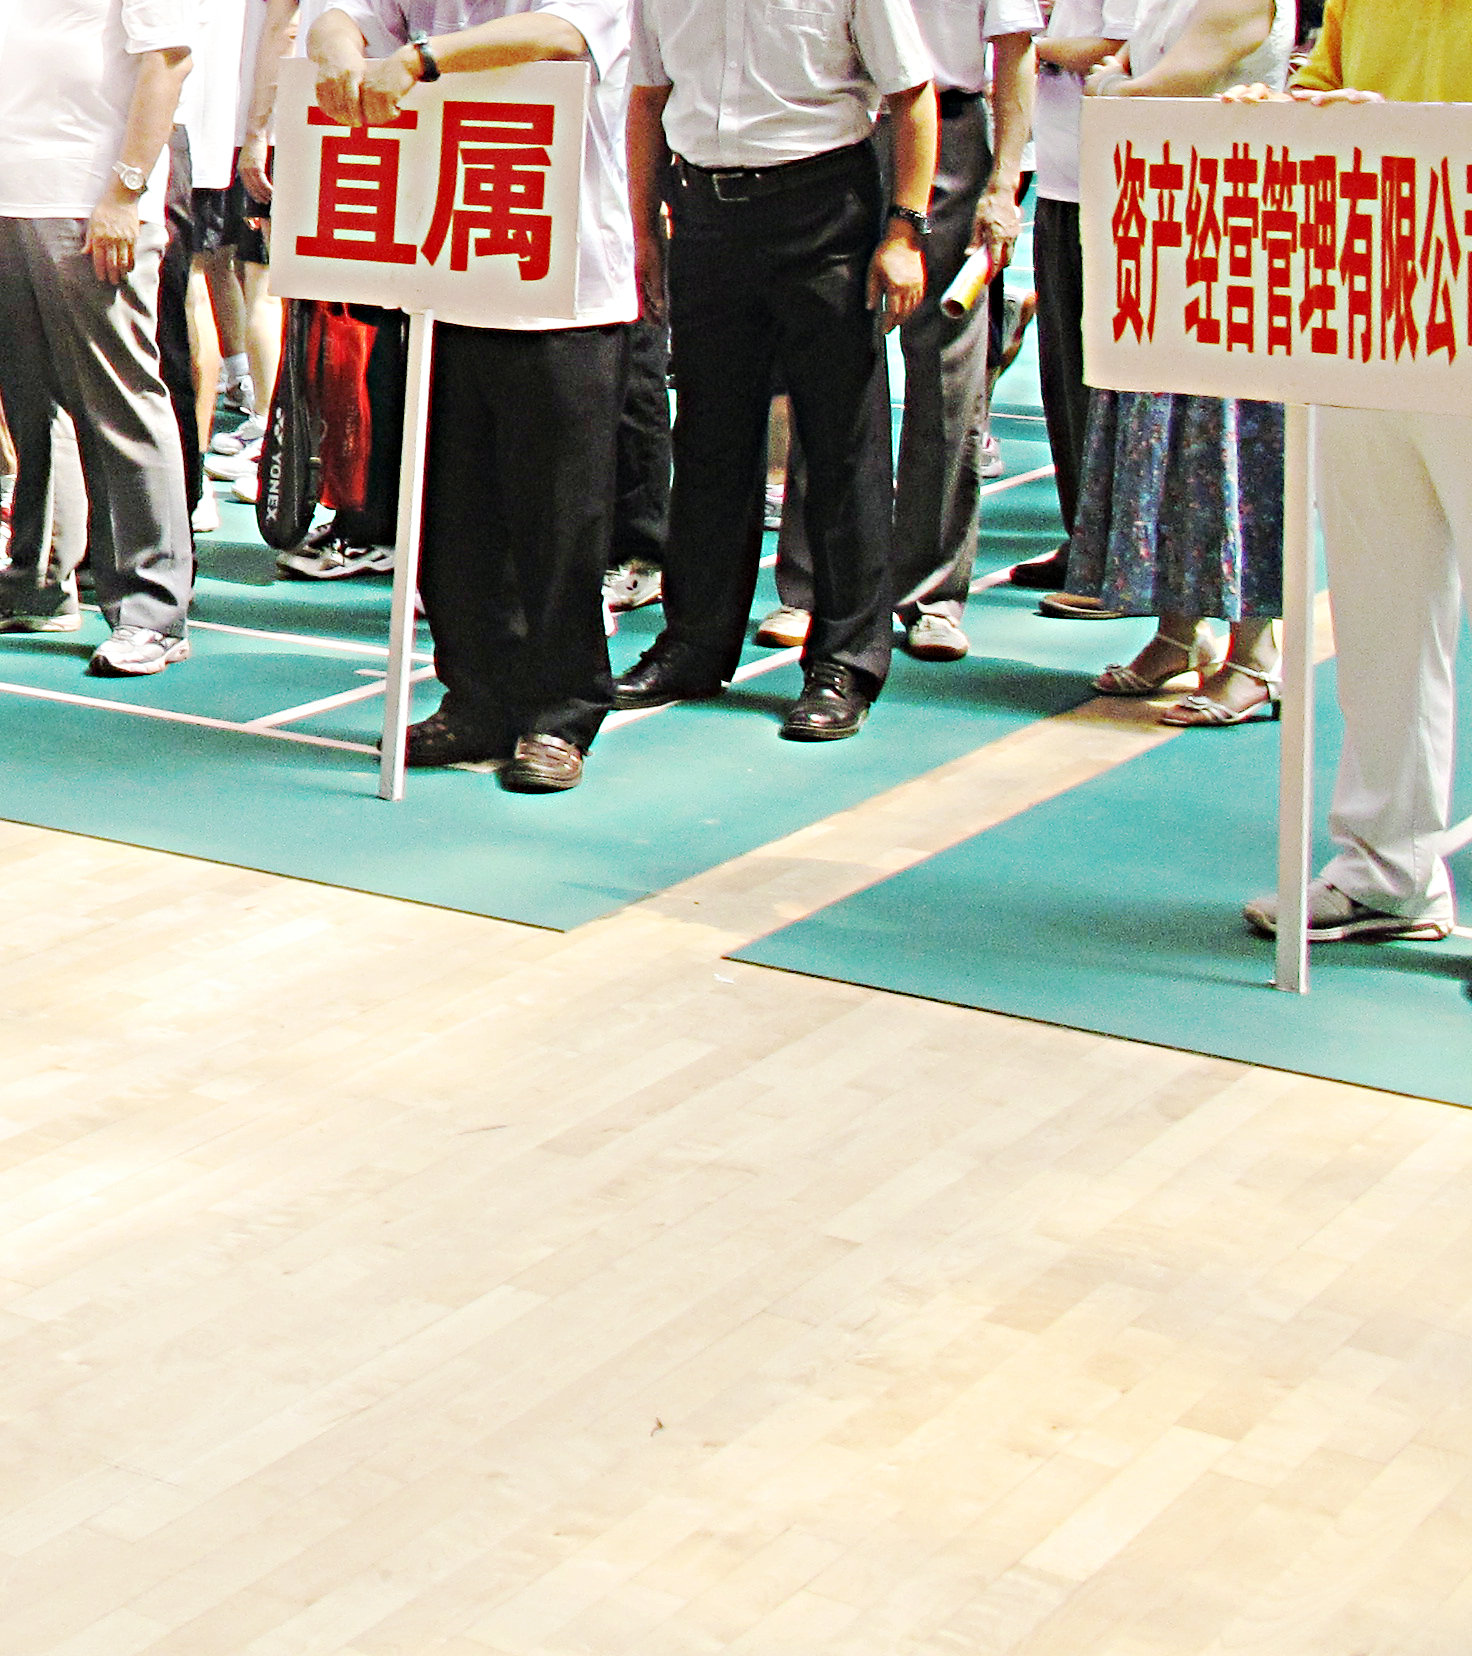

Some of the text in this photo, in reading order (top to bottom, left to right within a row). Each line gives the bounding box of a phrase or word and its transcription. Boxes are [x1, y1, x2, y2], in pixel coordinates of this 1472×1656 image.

[295, 100, 555, 281] 直属
[1112, 140, 1472, 365] 资产经营管理有限公
[265, 451, 282, 523] YONEX
